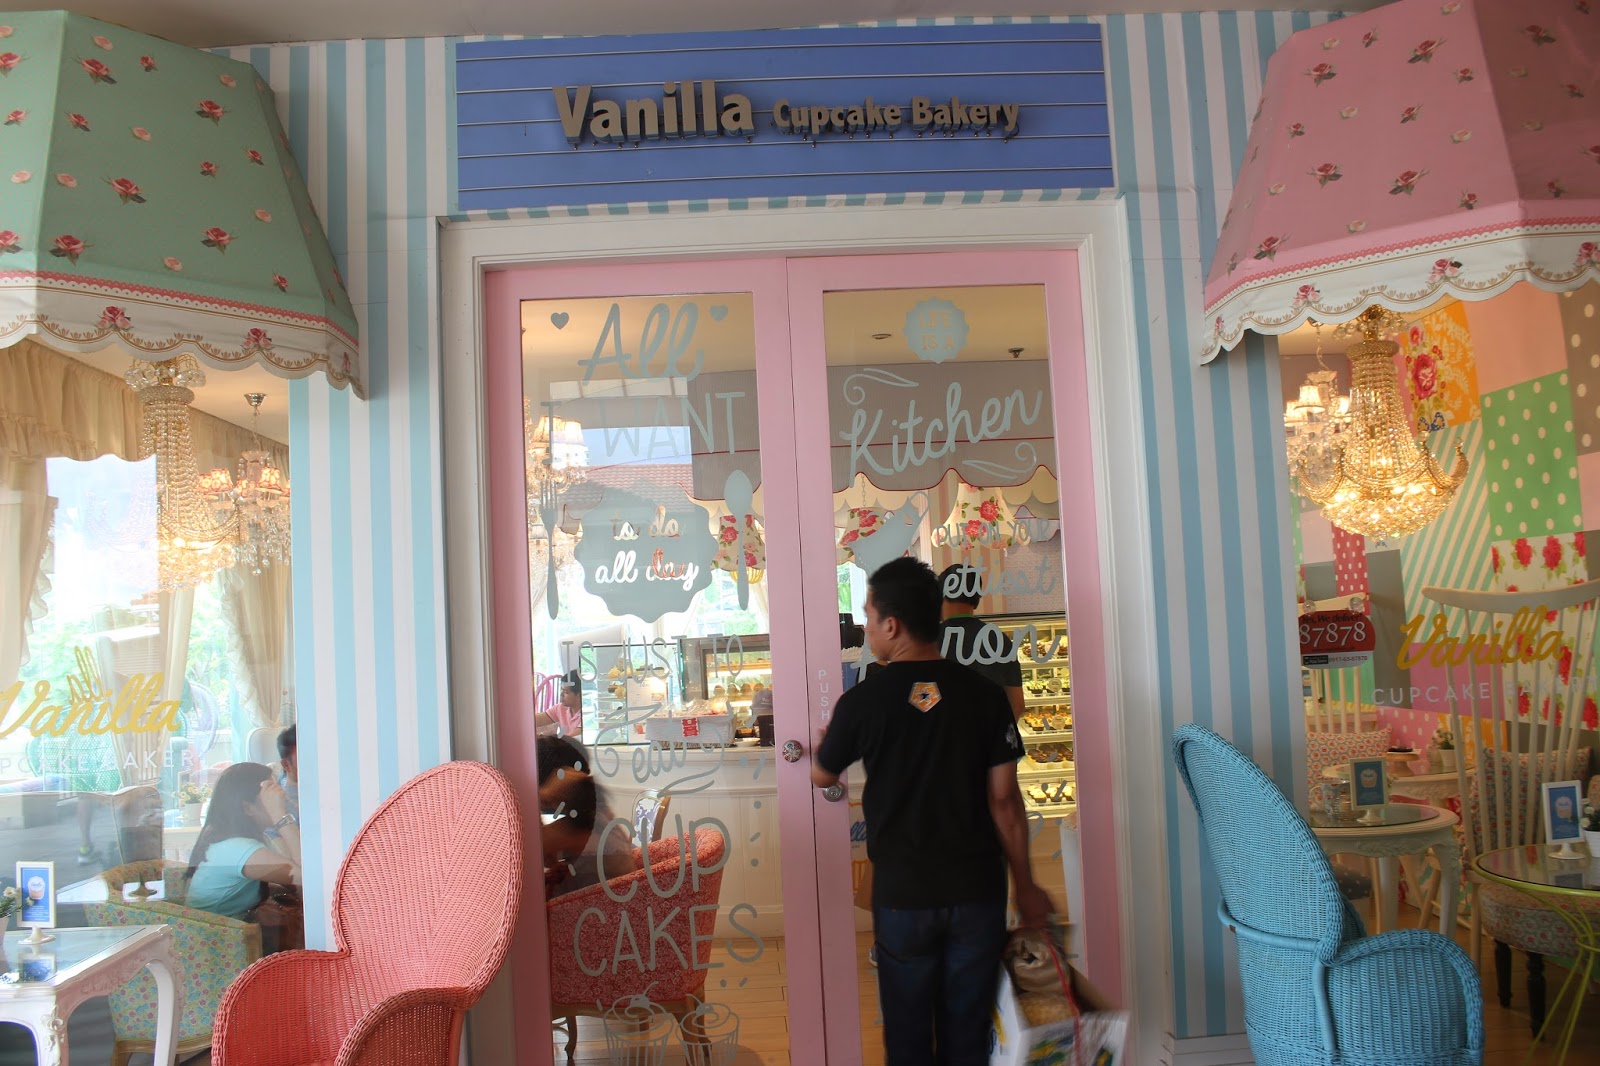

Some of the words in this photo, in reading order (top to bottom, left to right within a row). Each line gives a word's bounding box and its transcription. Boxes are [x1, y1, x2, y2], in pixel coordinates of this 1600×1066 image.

[552, 80, 755, 141] Vanilla
[772, 97, 902, 135] Cupcake
[911, 96, 1021, 133] Bakery
[577, 302, 705, 386] All
[599, 391, 746, 459] WANT
[839, 381, 1044, 488] Kitchen
[935, 522, 969, 548] PUT
[978, 520, 1000, 545] ON
[595, 549, 639, 584] all
[645, 547, 699, 591] day
[942, 553, 1057, 599] ettiest
[562, 640, 597, 687] IS
[617, 634, 688, 684] JUST
[707, 633, 744, 678] TO
[1299, 621, 1366, 648] 87878
[1396, 605, 1565, 670] Vanilla
[0, 672, 183, 737] Vanilla
[818, 669, 830, 720] PUSH
[1371, 681, 1491, 705] CUPCAKE
[0, 752, 91, 774] PCAKE
[597, 813, 732, 903] CUP
[573, 903, 765, 977] CAKES
